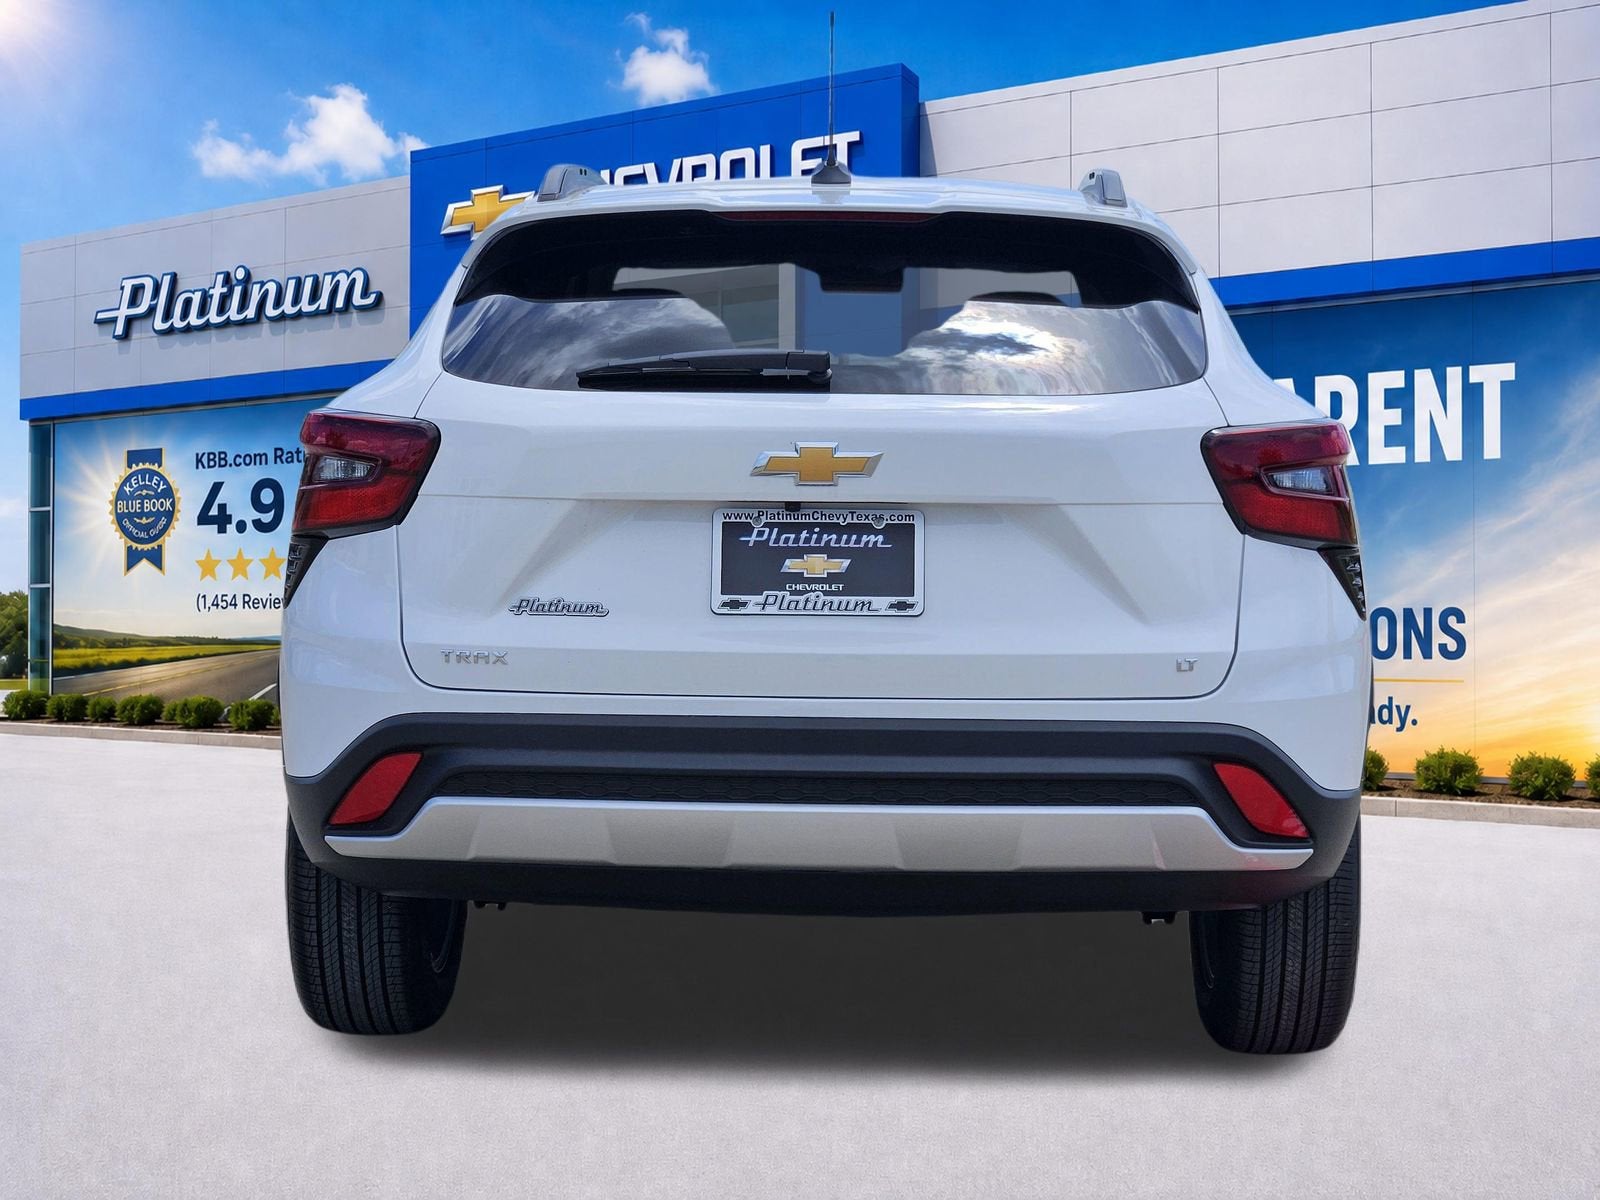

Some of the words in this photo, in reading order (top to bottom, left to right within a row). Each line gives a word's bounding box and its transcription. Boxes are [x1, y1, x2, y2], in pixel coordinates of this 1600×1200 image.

[600, 131, 860, 185] ROLET
[95, 265, 382, 339] Platinum
[1273, 362, 1516, 466] RENT
[195, 451, 269, 470] KBB.com
[273, 447, 305, 465] Rat
[124, 473, 167, 496] KELLEY
[117, 500, 142, 513] BLUE
[143, 498, 173, 512] BOOK
[197, 477, 285, 534] 4.9
[722, 510, 915, 524] wwwPlatinumChevyTexas.com
[739, 527, 893, 548] Platinum
[786, 583, 844, 592] CHEVROLET
[196, 593, 238, 612] (1,454
[242, 592, 284, 610] Revie
[508, 597, 610, 617] Platinum
[754, 593, 883, 613] Platinum
[440, 649, 509, 666] TRAX
[1176, 657, 1200, 673] LT
